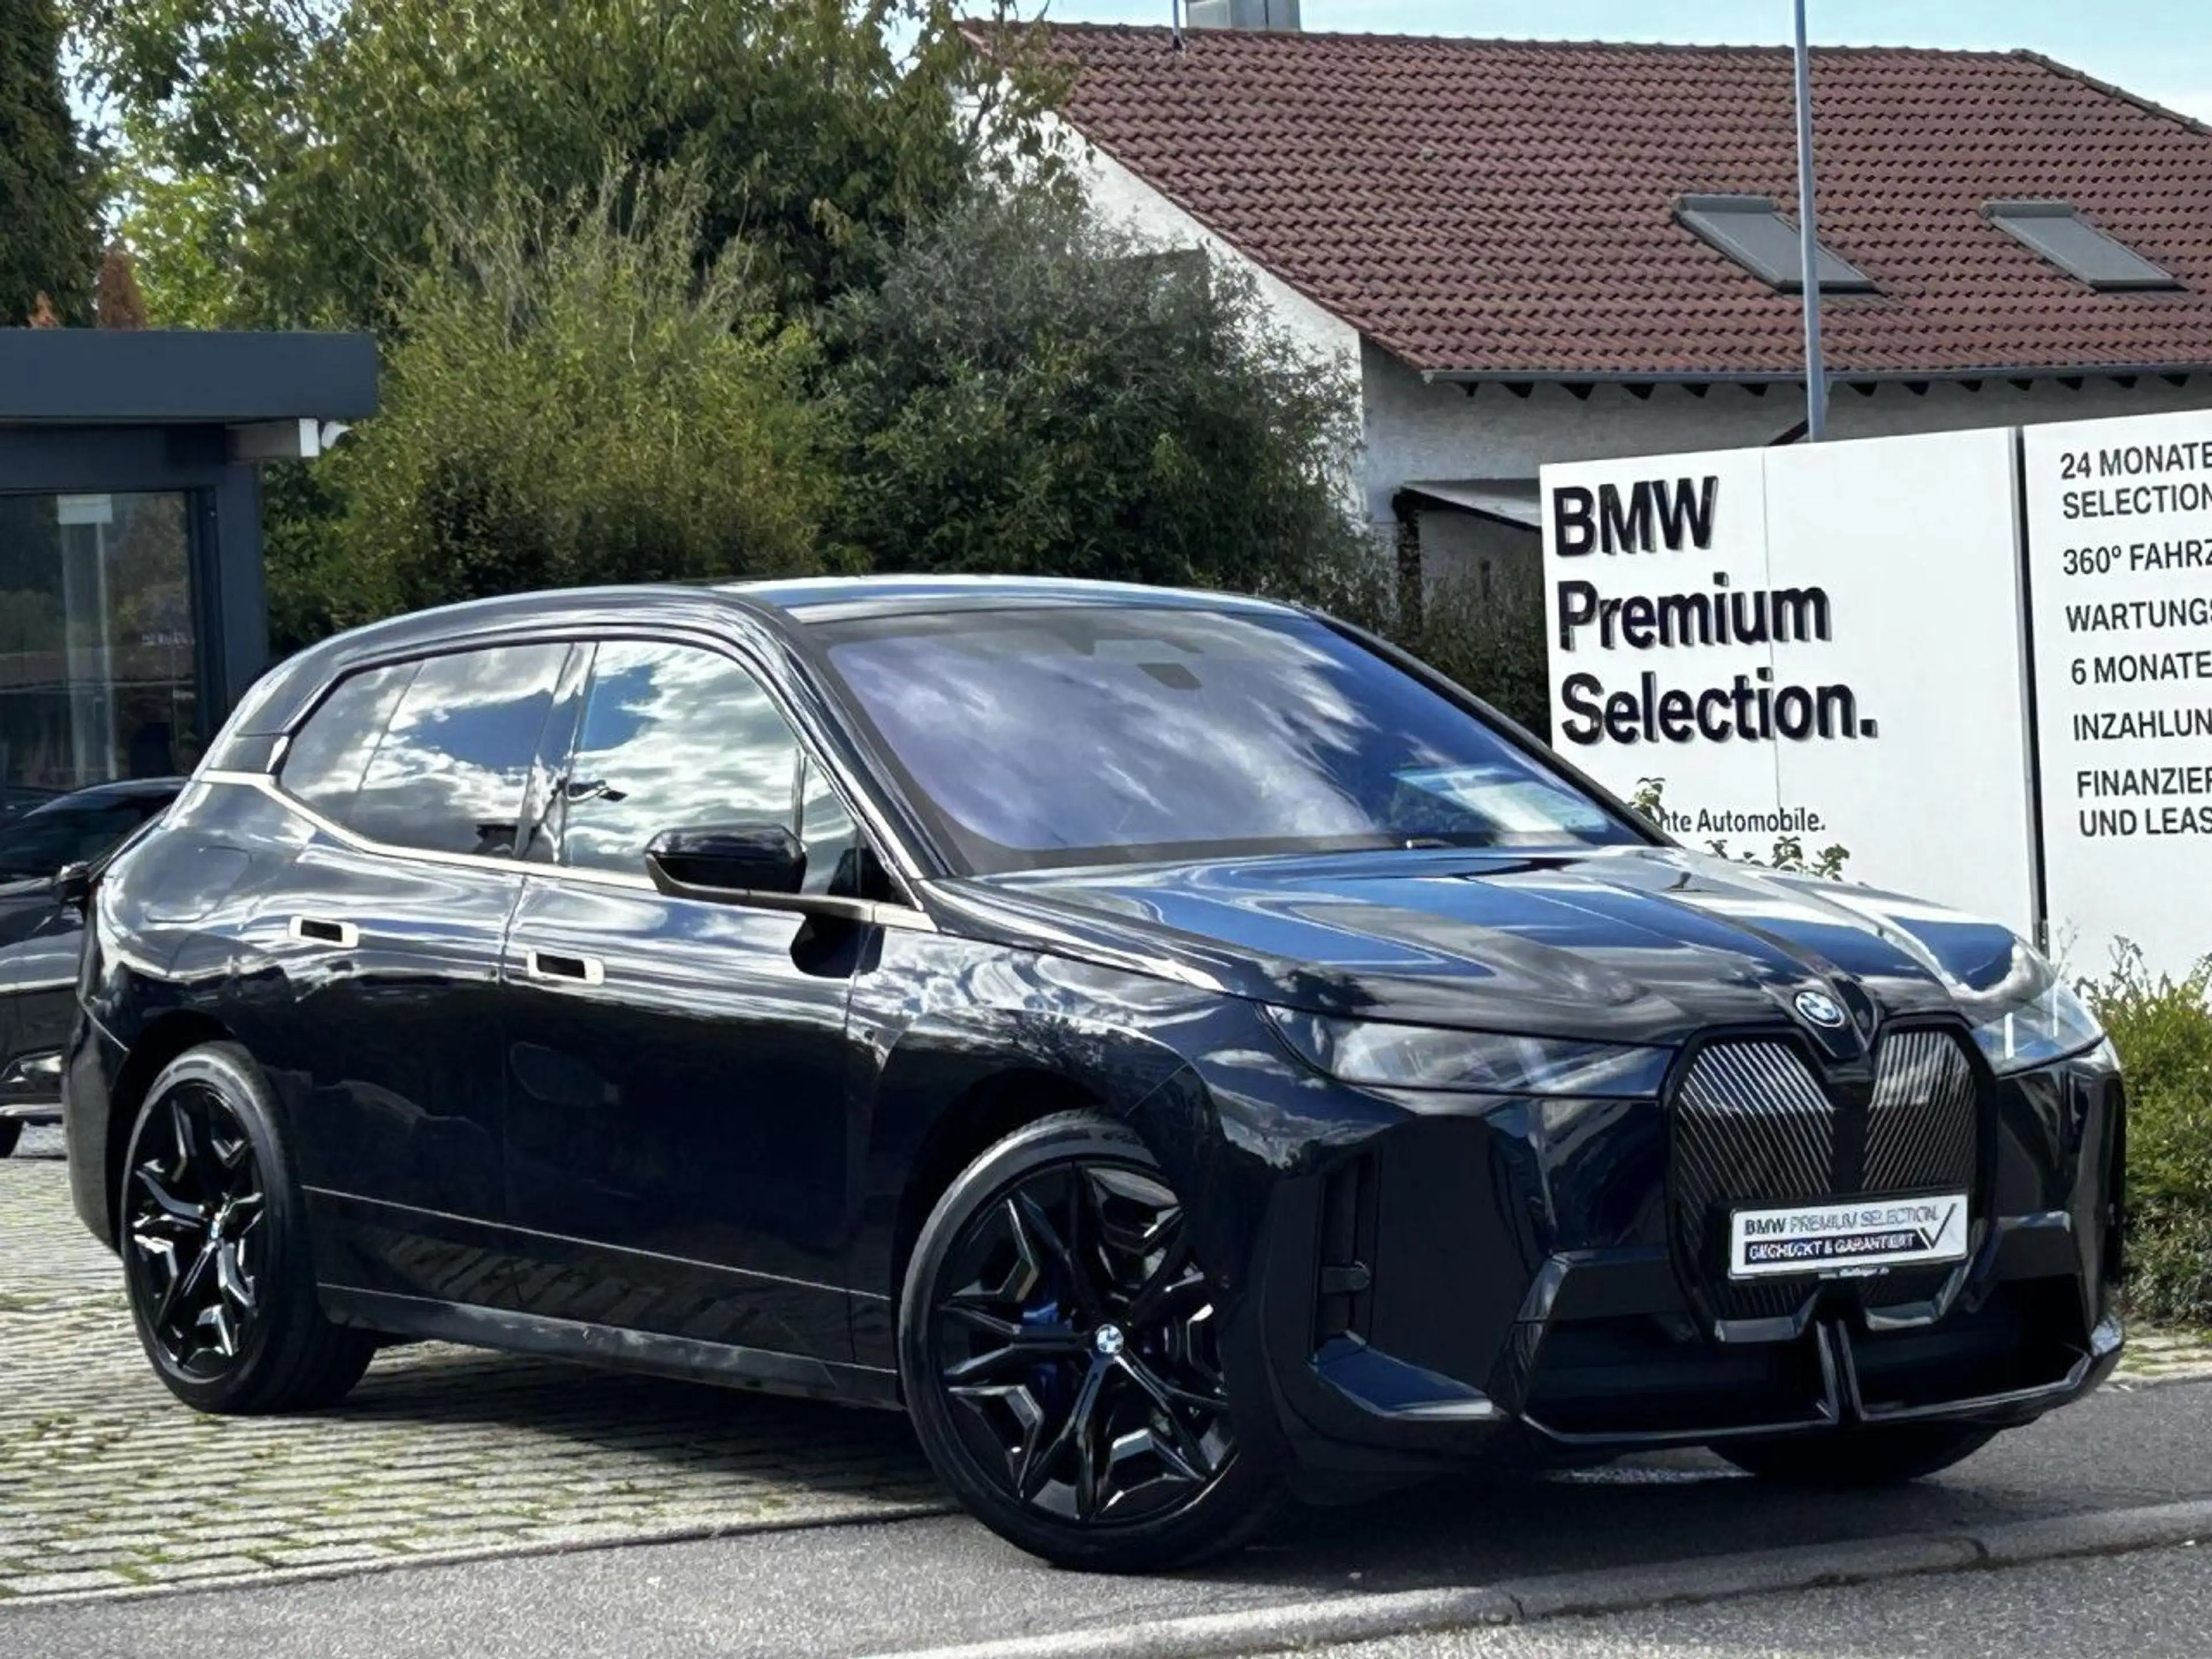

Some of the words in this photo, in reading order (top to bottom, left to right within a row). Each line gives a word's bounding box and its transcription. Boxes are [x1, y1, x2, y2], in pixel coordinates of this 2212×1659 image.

[2060, 452, 2092, 479] 24
[2099, 441, 2212, 476] MONATE
[1554, 475, 1718, 556] BMW
[2062, 482, 2212, 519] SELECTION
[1557, 571, 1832, 652] Premium
[2065, 597, 2212, 632] WARTUNG
[2071, 658, 2086, 685] 6
[2094, 650, 2212, 684] MONATE
[1561, 666, 1878, 745] Selection.
[2073, 708, 2212, 741] INZAHLUN
[1696, 807, 1825, 833] Automobile.
[2079, 809, 2137, 837] UND
[2145, 805, 2212, 835] LEAS
[1744, 1218, 1786, 1236] BMW
